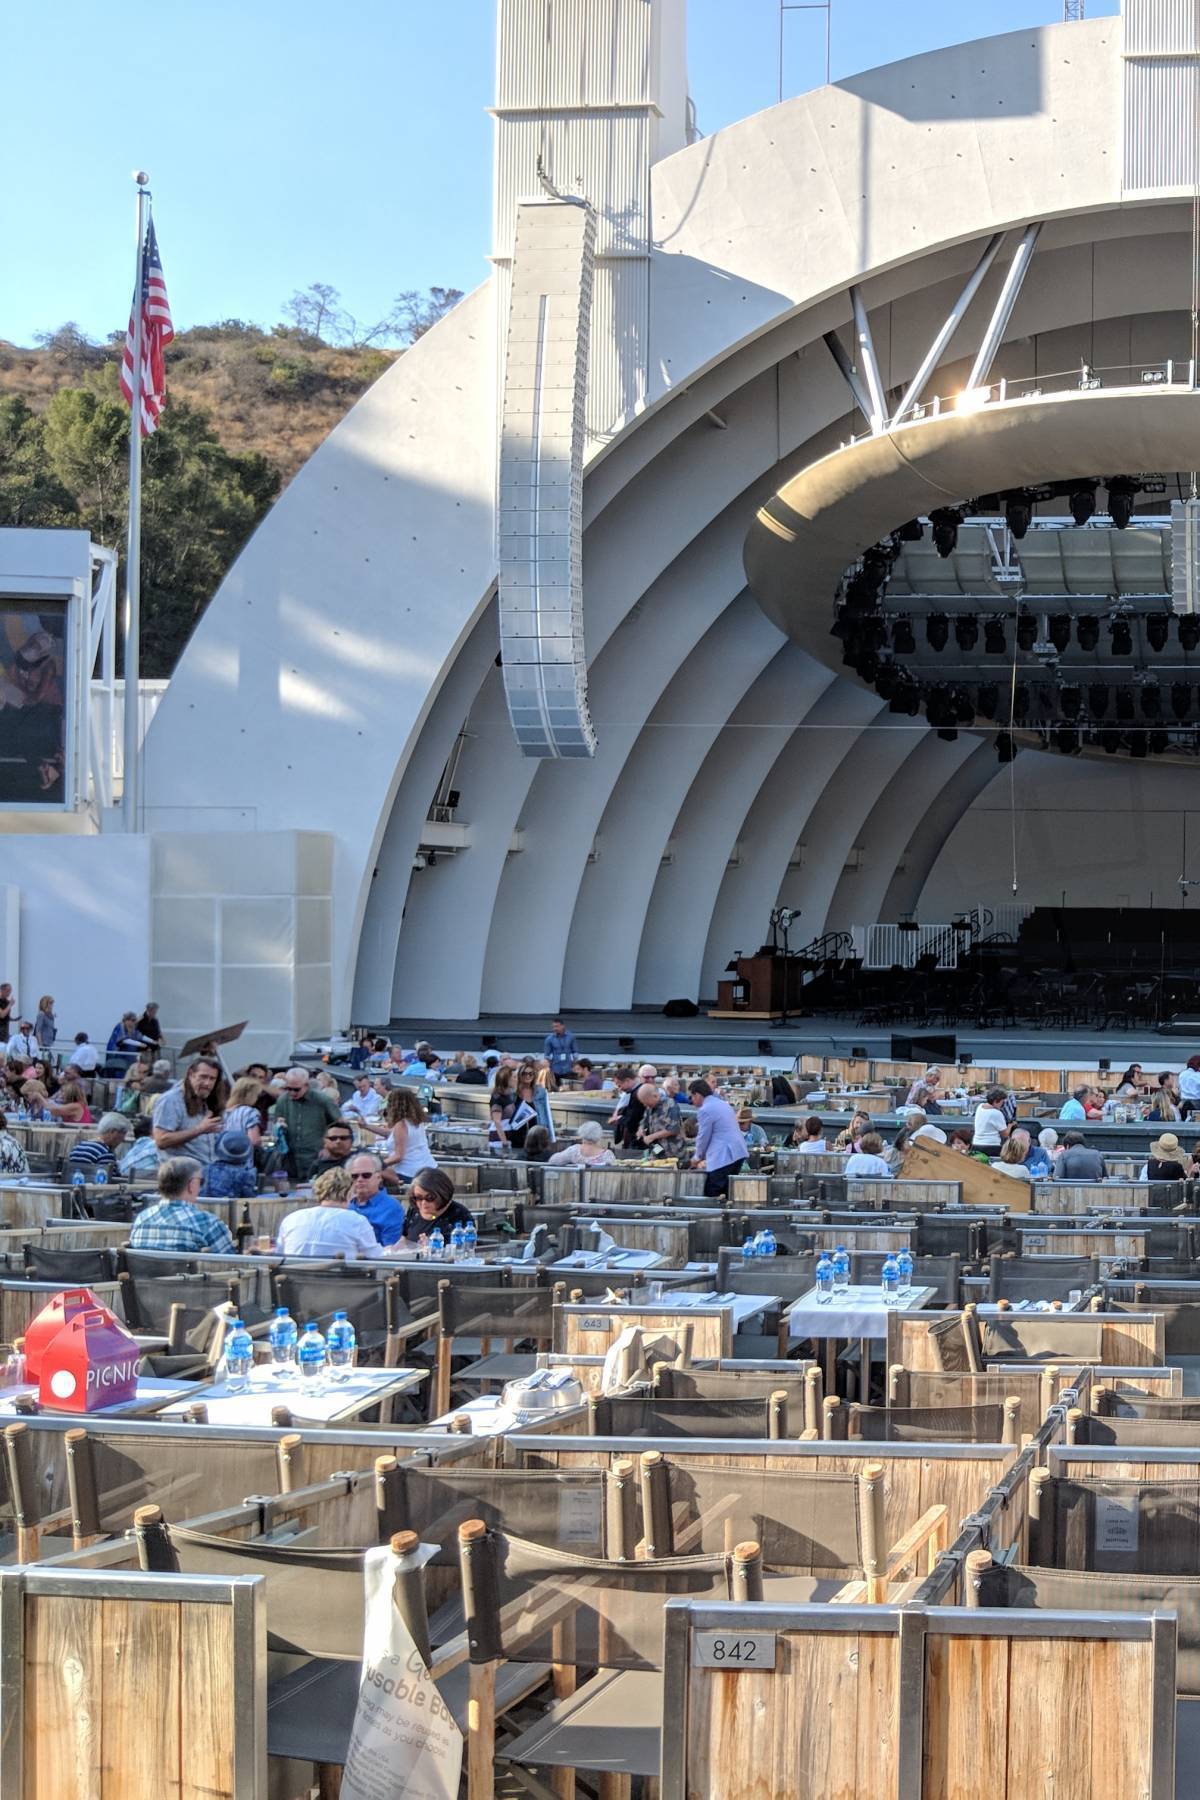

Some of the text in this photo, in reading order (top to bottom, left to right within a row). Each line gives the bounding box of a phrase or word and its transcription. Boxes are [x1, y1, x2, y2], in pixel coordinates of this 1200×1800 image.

[584, 1320, 602, 1328] 643
[86, 1360, 140, 1391] PICNIC
[713, 1640, 756, 1661] 842
[367, 1667, 427, 1707] usable
[393, 1732, 413, 1746] you
